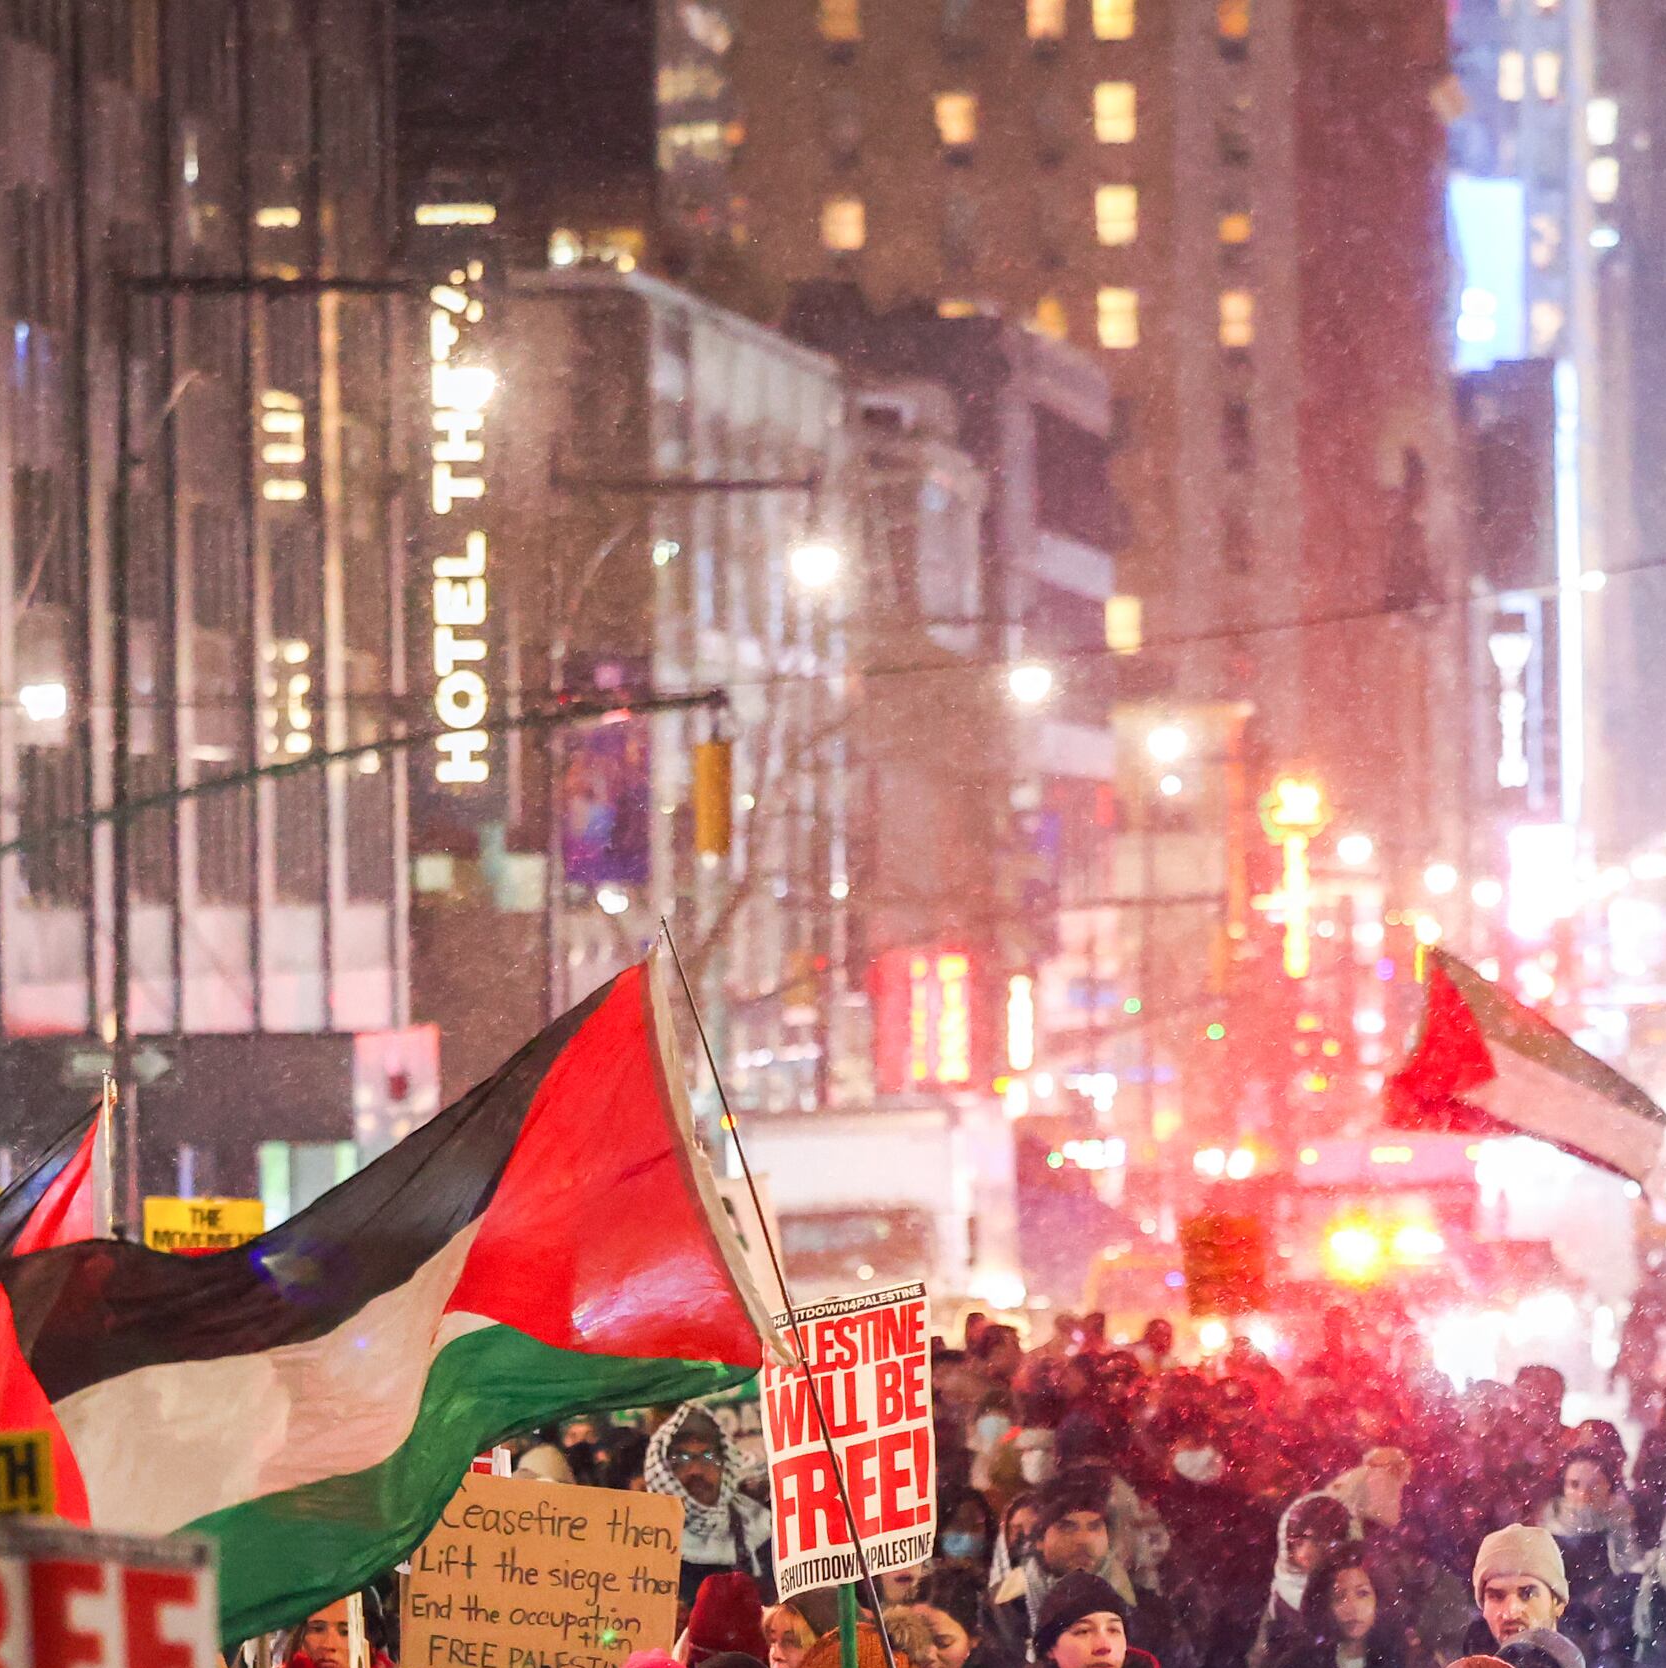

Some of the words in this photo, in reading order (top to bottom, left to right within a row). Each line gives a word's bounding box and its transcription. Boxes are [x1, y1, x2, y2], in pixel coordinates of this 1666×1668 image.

[434, 530, 489, 783] HOTEL
[766, 1371, 868, 1452] WILL
[876, 1354, 927, 1427] BE
[772, 1426, 930, 1561] FREE!
[411, 1593, 453, 1621] End
[459, 1594, 500, 1624] the
[419, 1545, 477, 1579] Lift
[494, 1551, 539, 1586] the
[549, 1560, 621, 1606] siege
[429, 1634, 498, 1668] FREE
